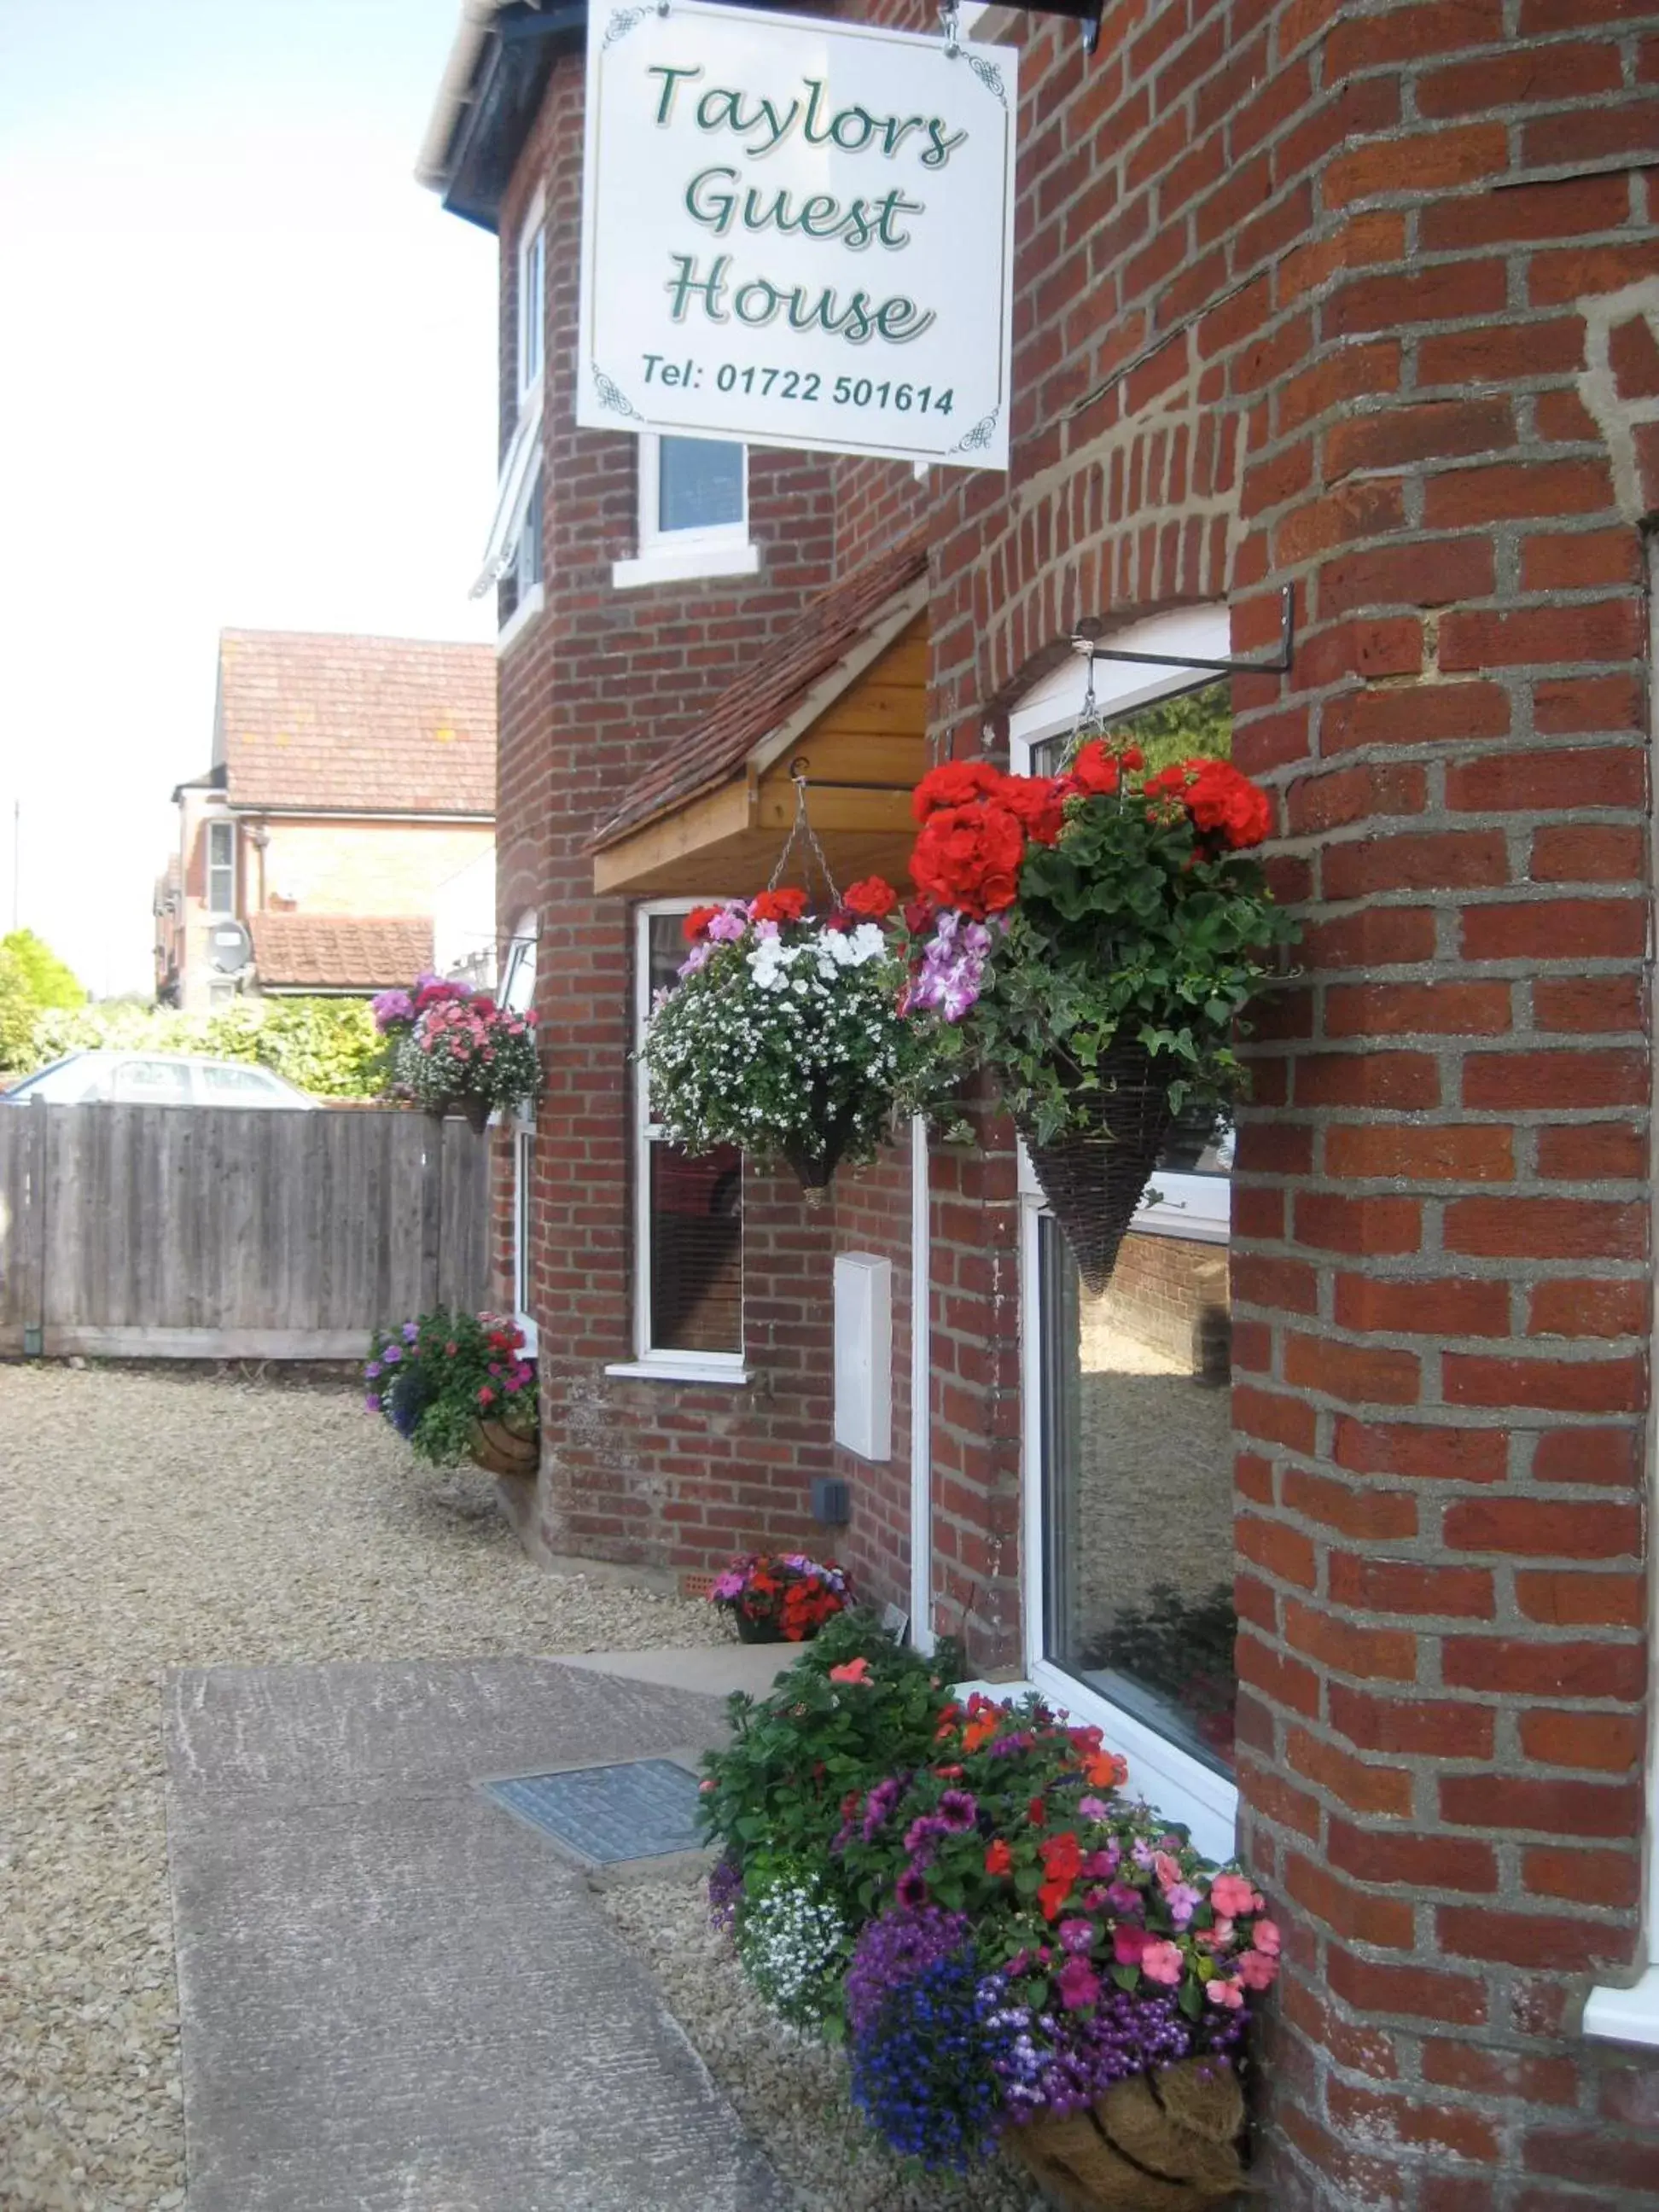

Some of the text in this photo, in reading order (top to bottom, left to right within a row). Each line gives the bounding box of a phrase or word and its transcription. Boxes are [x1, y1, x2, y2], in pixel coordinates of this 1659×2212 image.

[649, 66, 966, 166] Taylors
[685, 166, 923, 247] Guest
[668, 254, 934, 343] House
[643, 354, 954, 416] Tel: 01722 501614
